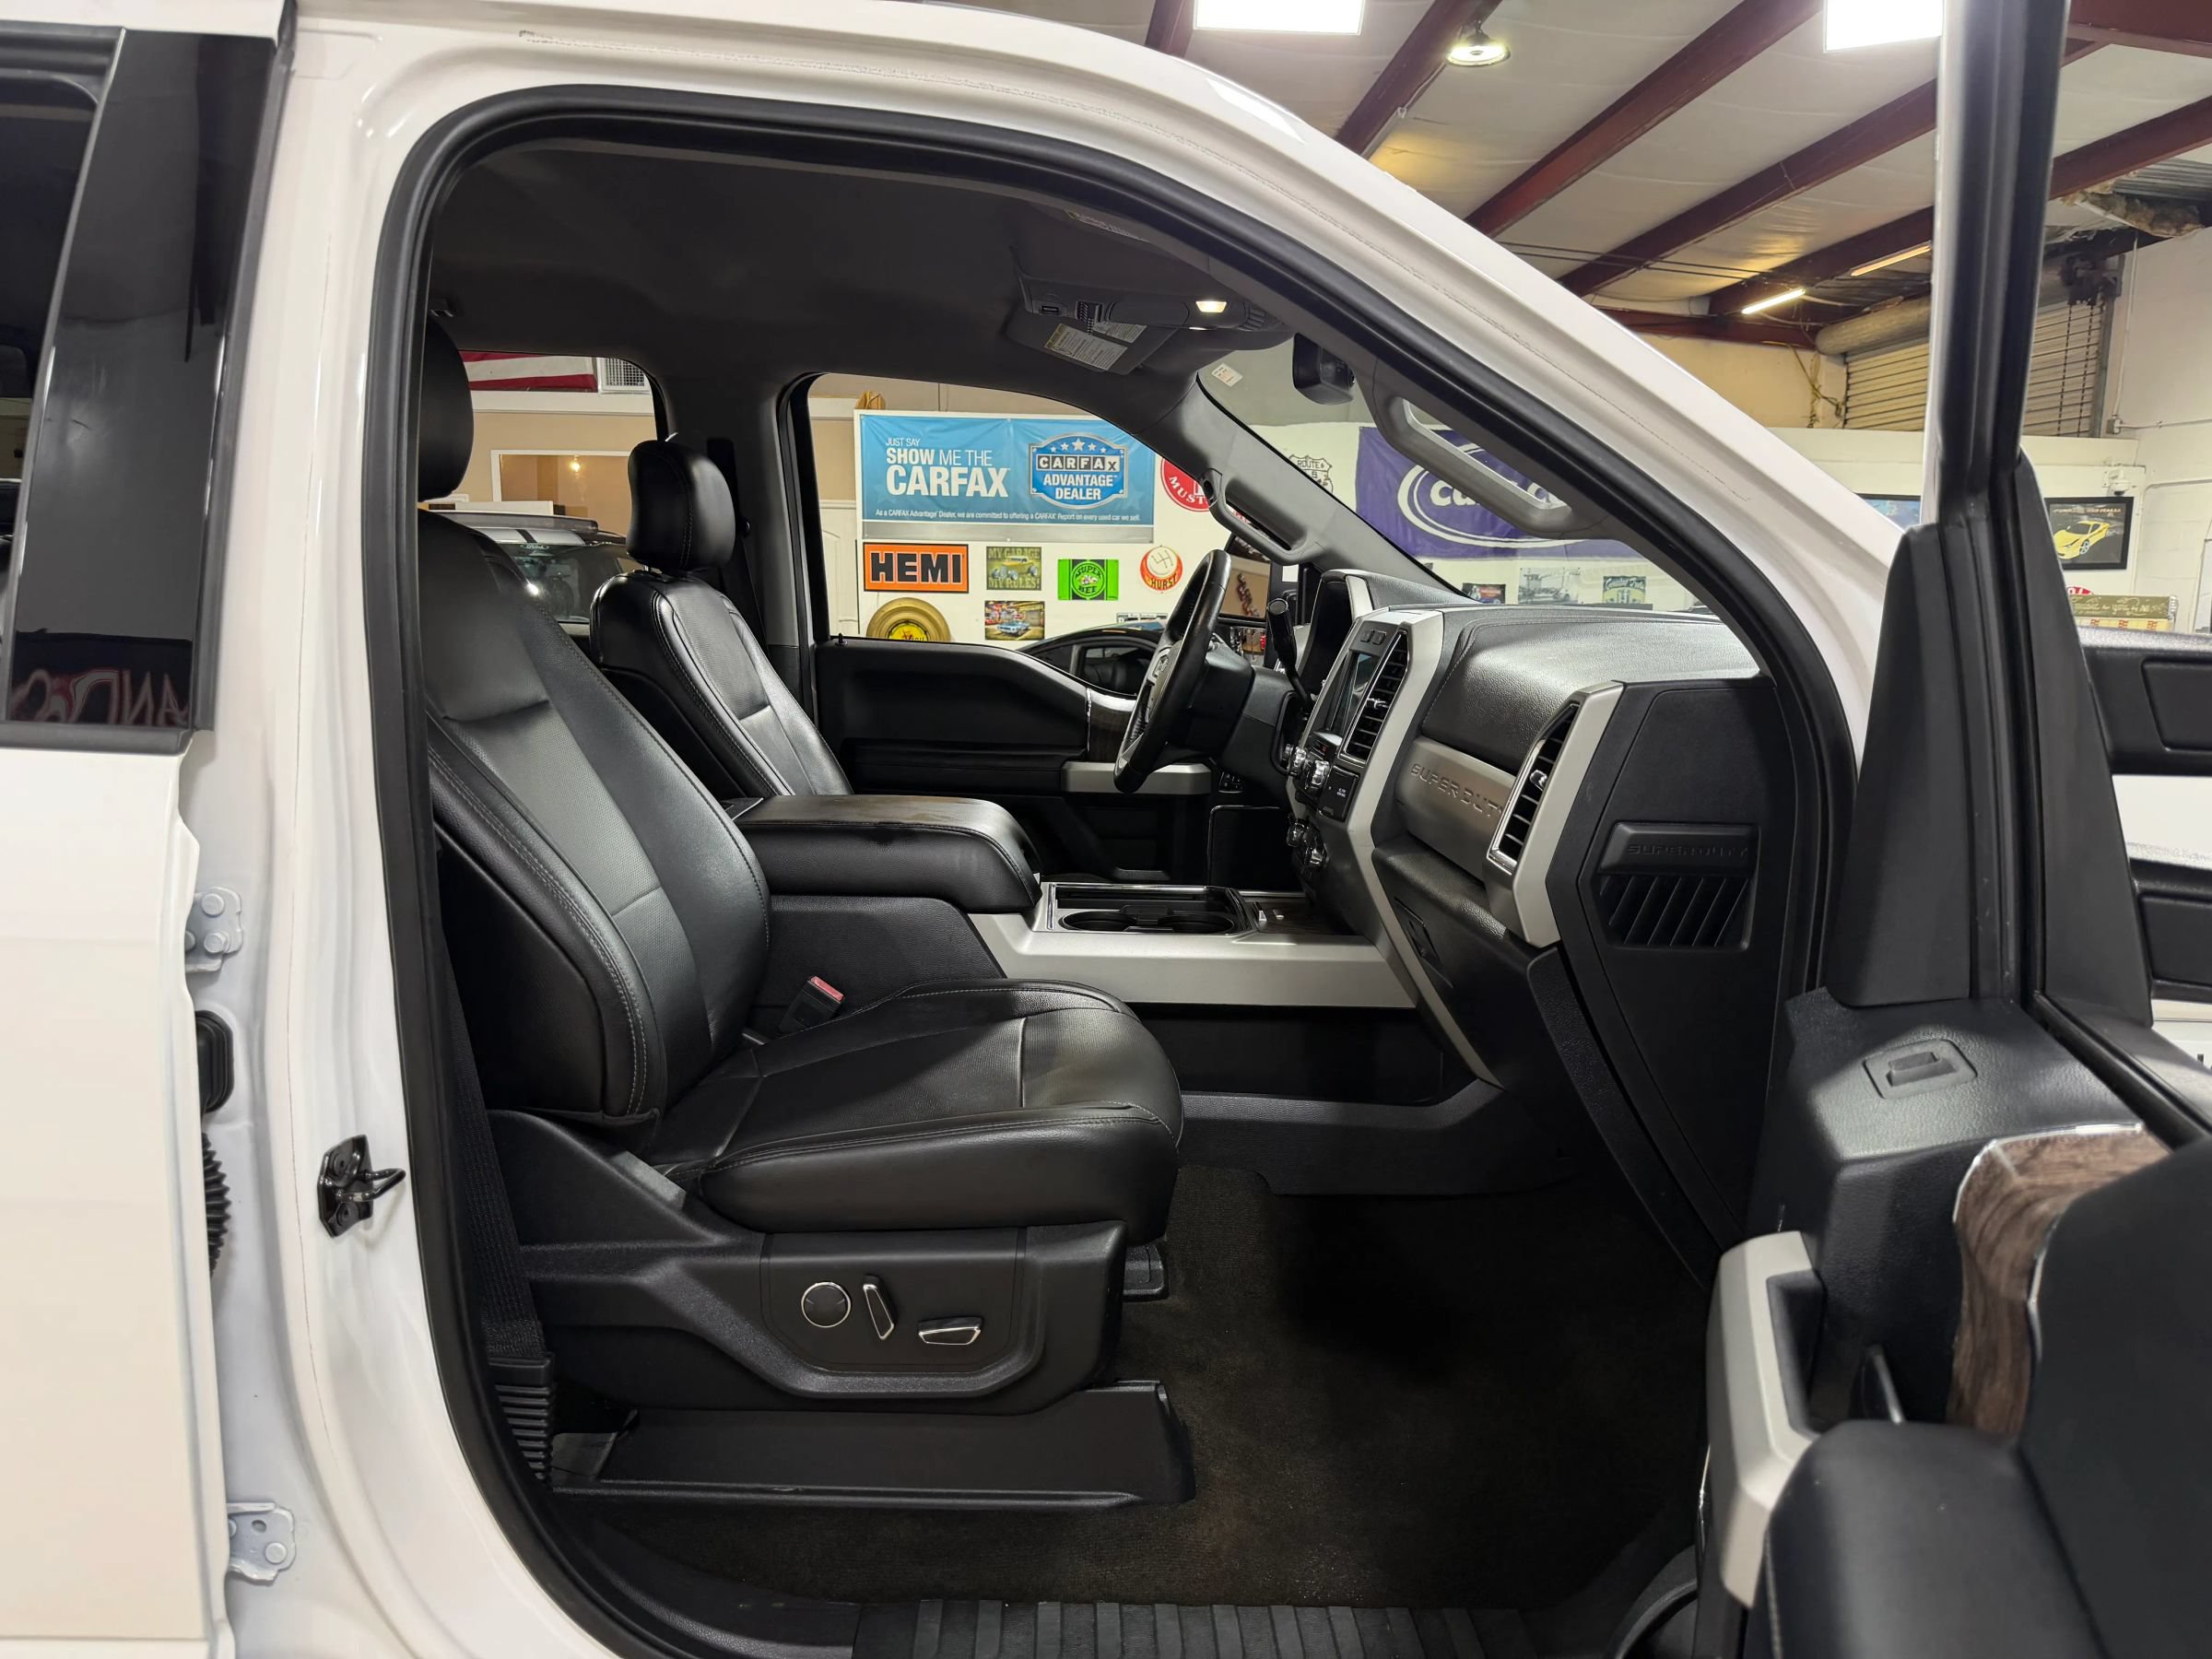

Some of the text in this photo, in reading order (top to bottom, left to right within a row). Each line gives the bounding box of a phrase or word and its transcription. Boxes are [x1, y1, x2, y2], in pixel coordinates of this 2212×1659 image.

[886, 438, 921, 447] JUST SAY
[886, 447, 993, 466] SHOW ME THE
[1039, 456, 1117, 471] CARFAX
[886, 465, 1009, 498] CARFAX
[1042, 474, 1113, 487] ADVANTAGE
[1055, 488, 1101, 500] DEALER
[870, 551, 963, 584] HEMI
[1150, 571, 1178, 590] HURST
[1410, 763, 1461, 798] SUPER
